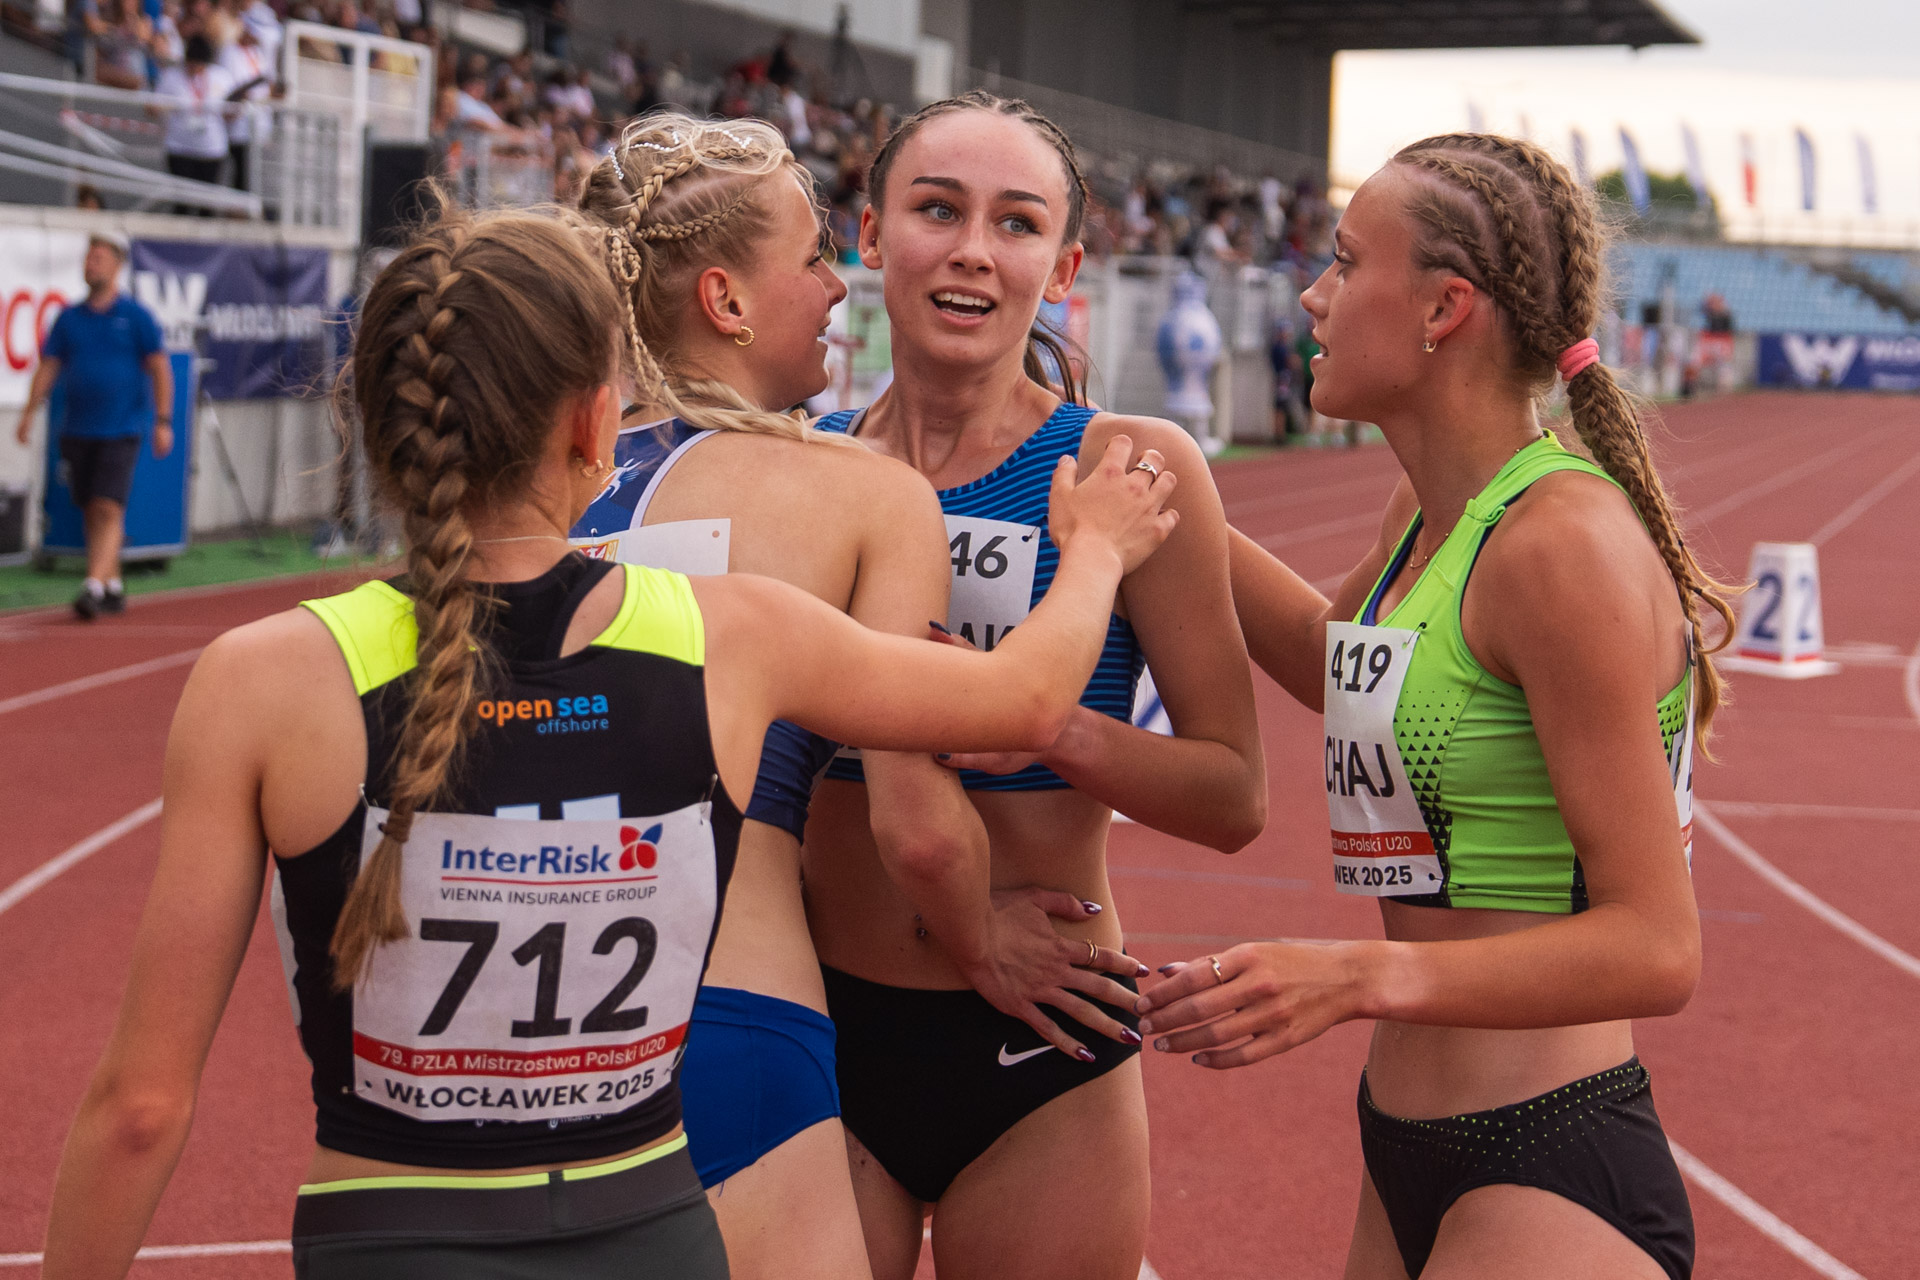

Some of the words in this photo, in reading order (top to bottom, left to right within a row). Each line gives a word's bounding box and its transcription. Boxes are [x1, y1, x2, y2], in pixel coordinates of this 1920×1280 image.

[1750, 570, 1784, 640] 2
[1330, 639, 1393, 694] 419
[477, 699, 553, 727] open
[557, 694, 609, 717] sea
[536, 718, 609, 734] offshore
[1325, 735, 1396, 798] CHAJ
[441, 840, 612, 875] InterRisk
[1349, 836, 1382, 852] Polski
[1385, 835, 1412, 851] U20
[1361, 865, 1413, 887] 2025
[440, 887, 503, 904] VIENNA
[508, 890, 601, 905] INSURANCE
[606, 886, 657, 901] GROUP
[417, 916, 658, 1038] 712
[380, 1045, 407, 1066] 79.
[411, 1054, 458, 1071] PZLA
[463, 1053, 580, 1073] Mistrzostwa
[586, 1045, 638, 1067] Polski
[639, 1036, 666, 1058] U20
[384, 1078, 590, 1109] WŁOCŁAWEK
[596, 1068, 655, 1103] 2025
